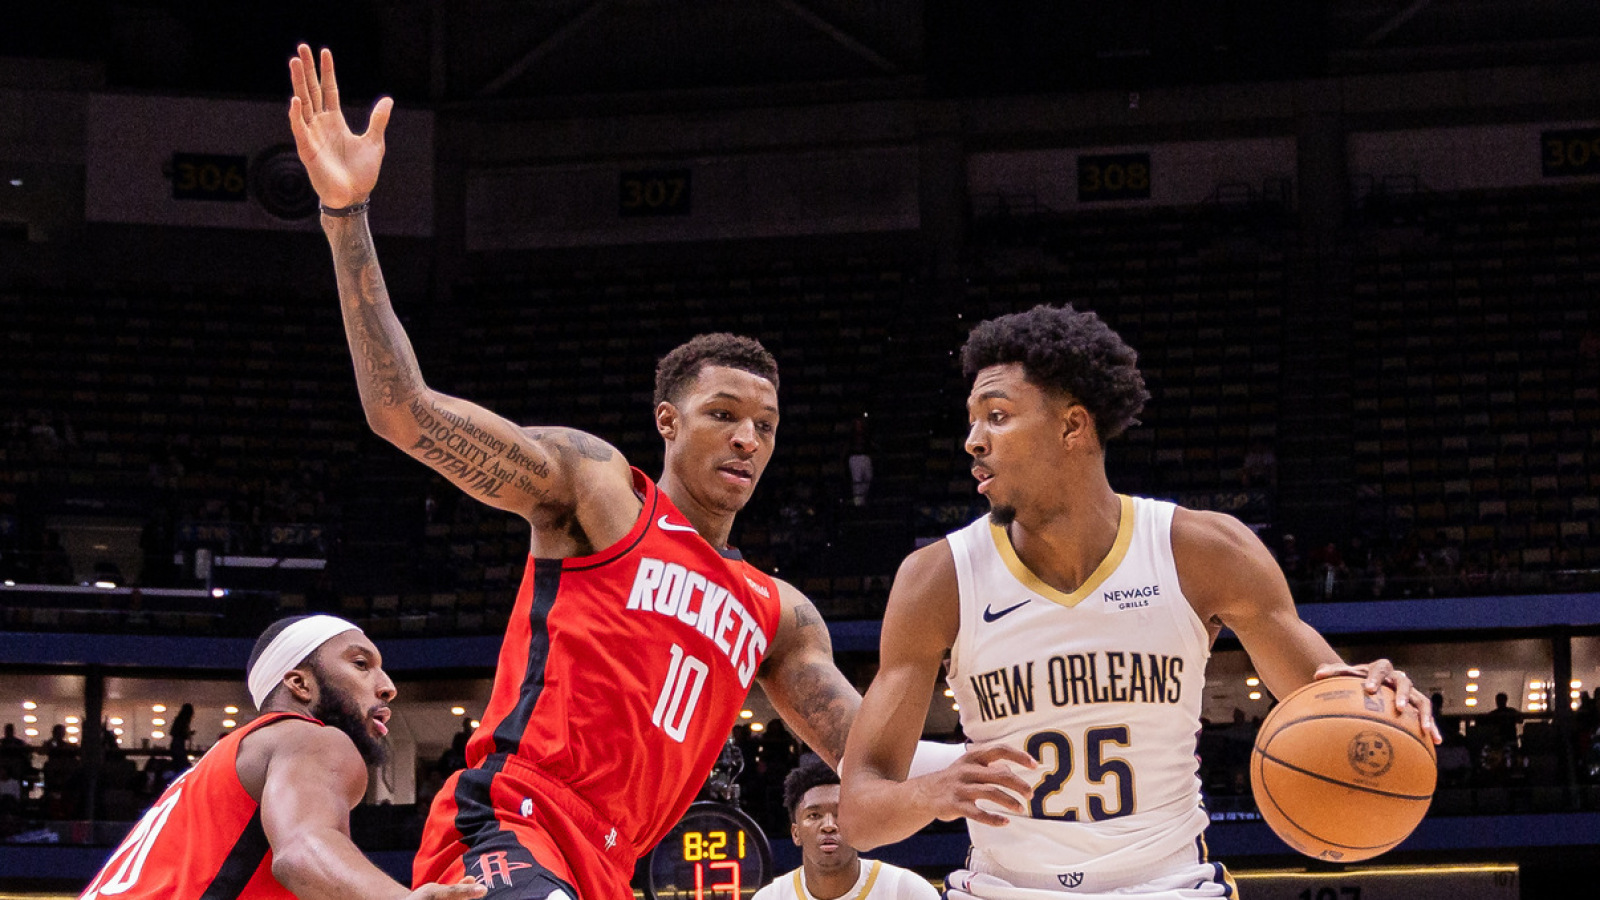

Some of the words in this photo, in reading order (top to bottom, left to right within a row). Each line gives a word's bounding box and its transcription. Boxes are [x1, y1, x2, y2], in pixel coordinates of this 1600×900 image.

[177, 161, 244, 193] 306
[621, 176, 686, 208] 307
[1080, 161, 1149, 193] 308
[408, 398, 493, 467] MEDIOCRITY
[487, 461, 517, 484] And
[412, 433, 503, 499] POTENTIAL
[431, 401, 507, 457] Complacency
[507, 442, 550, 478] Breeds
[626, 557, 768, 689] ROCKETS
[1103, 585, 1160, 603] NEWAGE
[1118, 600, 1149, 611] GRILLS
[652, 642, 709, 743] 10
[970, 660, 1035, 722] NEW
[1048, 651, 1184, 707] ORLEANS
[1023, 723, 1137, 823] 25
[683, 830, 745, 861] 8:21
